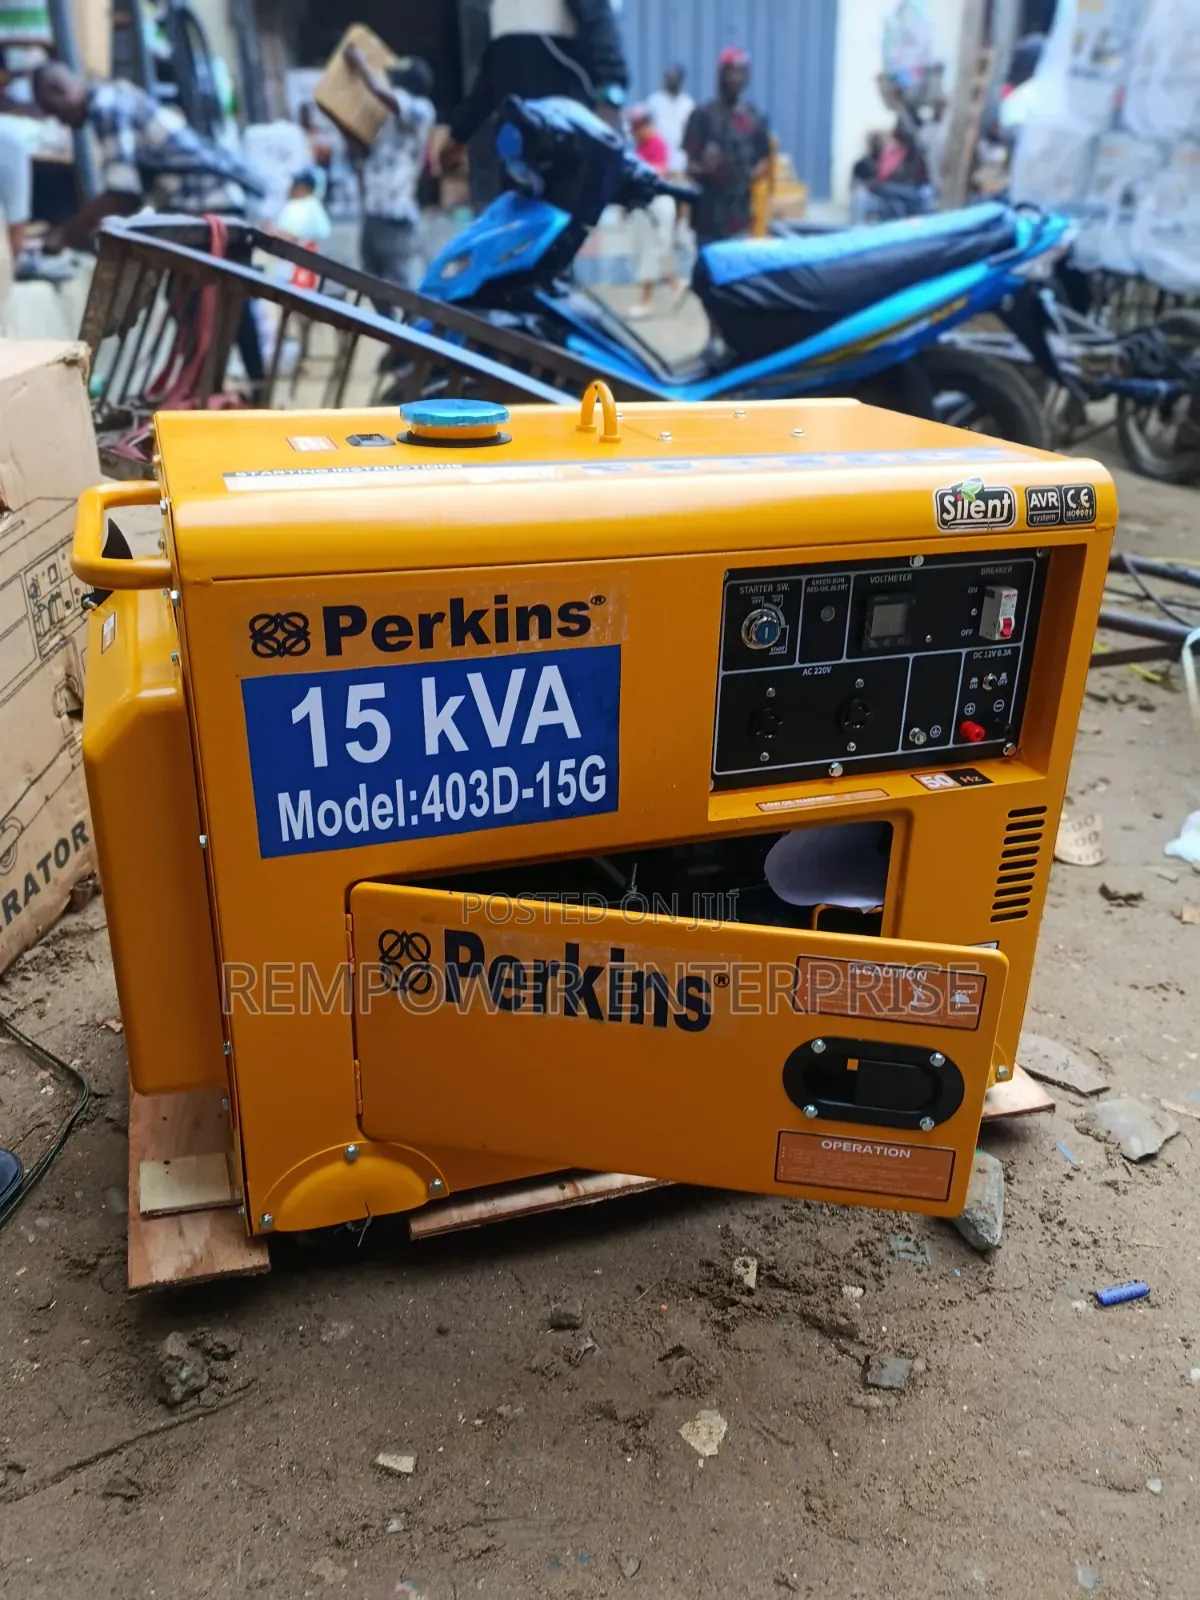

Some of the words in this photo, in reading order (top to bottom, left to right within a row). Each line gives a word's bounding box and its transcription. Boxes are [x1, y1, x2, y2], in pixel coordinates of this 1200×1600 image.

[235, 467, 329, 477] STARTING
[1030, 491, 1059, 508] AVR
[1066, 488, 1091, 509] CE
[942, 492, 1011, 521] Silent
[1032, 514, 1057, 523] system
[980, 566, 1013, 576] BREAKER
[869, 573, 913, 584] VOLTMETER
[739, 583, 774, 595] STARTER
[967, 586, 979, 594] ON
[960, 628, 974, 637] OFF
[973, 651, 984, 660] DC
[802, 667, 813, 677] AC
[813, 665, 832, 675] 220V
[291, 682, 392, 768] 15
[421, 664, 582, 756] kVA
[919, 775, 955, 789] 50
[959, 774, 982, 784] Hz
[0, 820, 90, 934] RATOR
[862, 964, 928, 982] CAUTION
[820, 1139, 911, 1159] OPERATION
